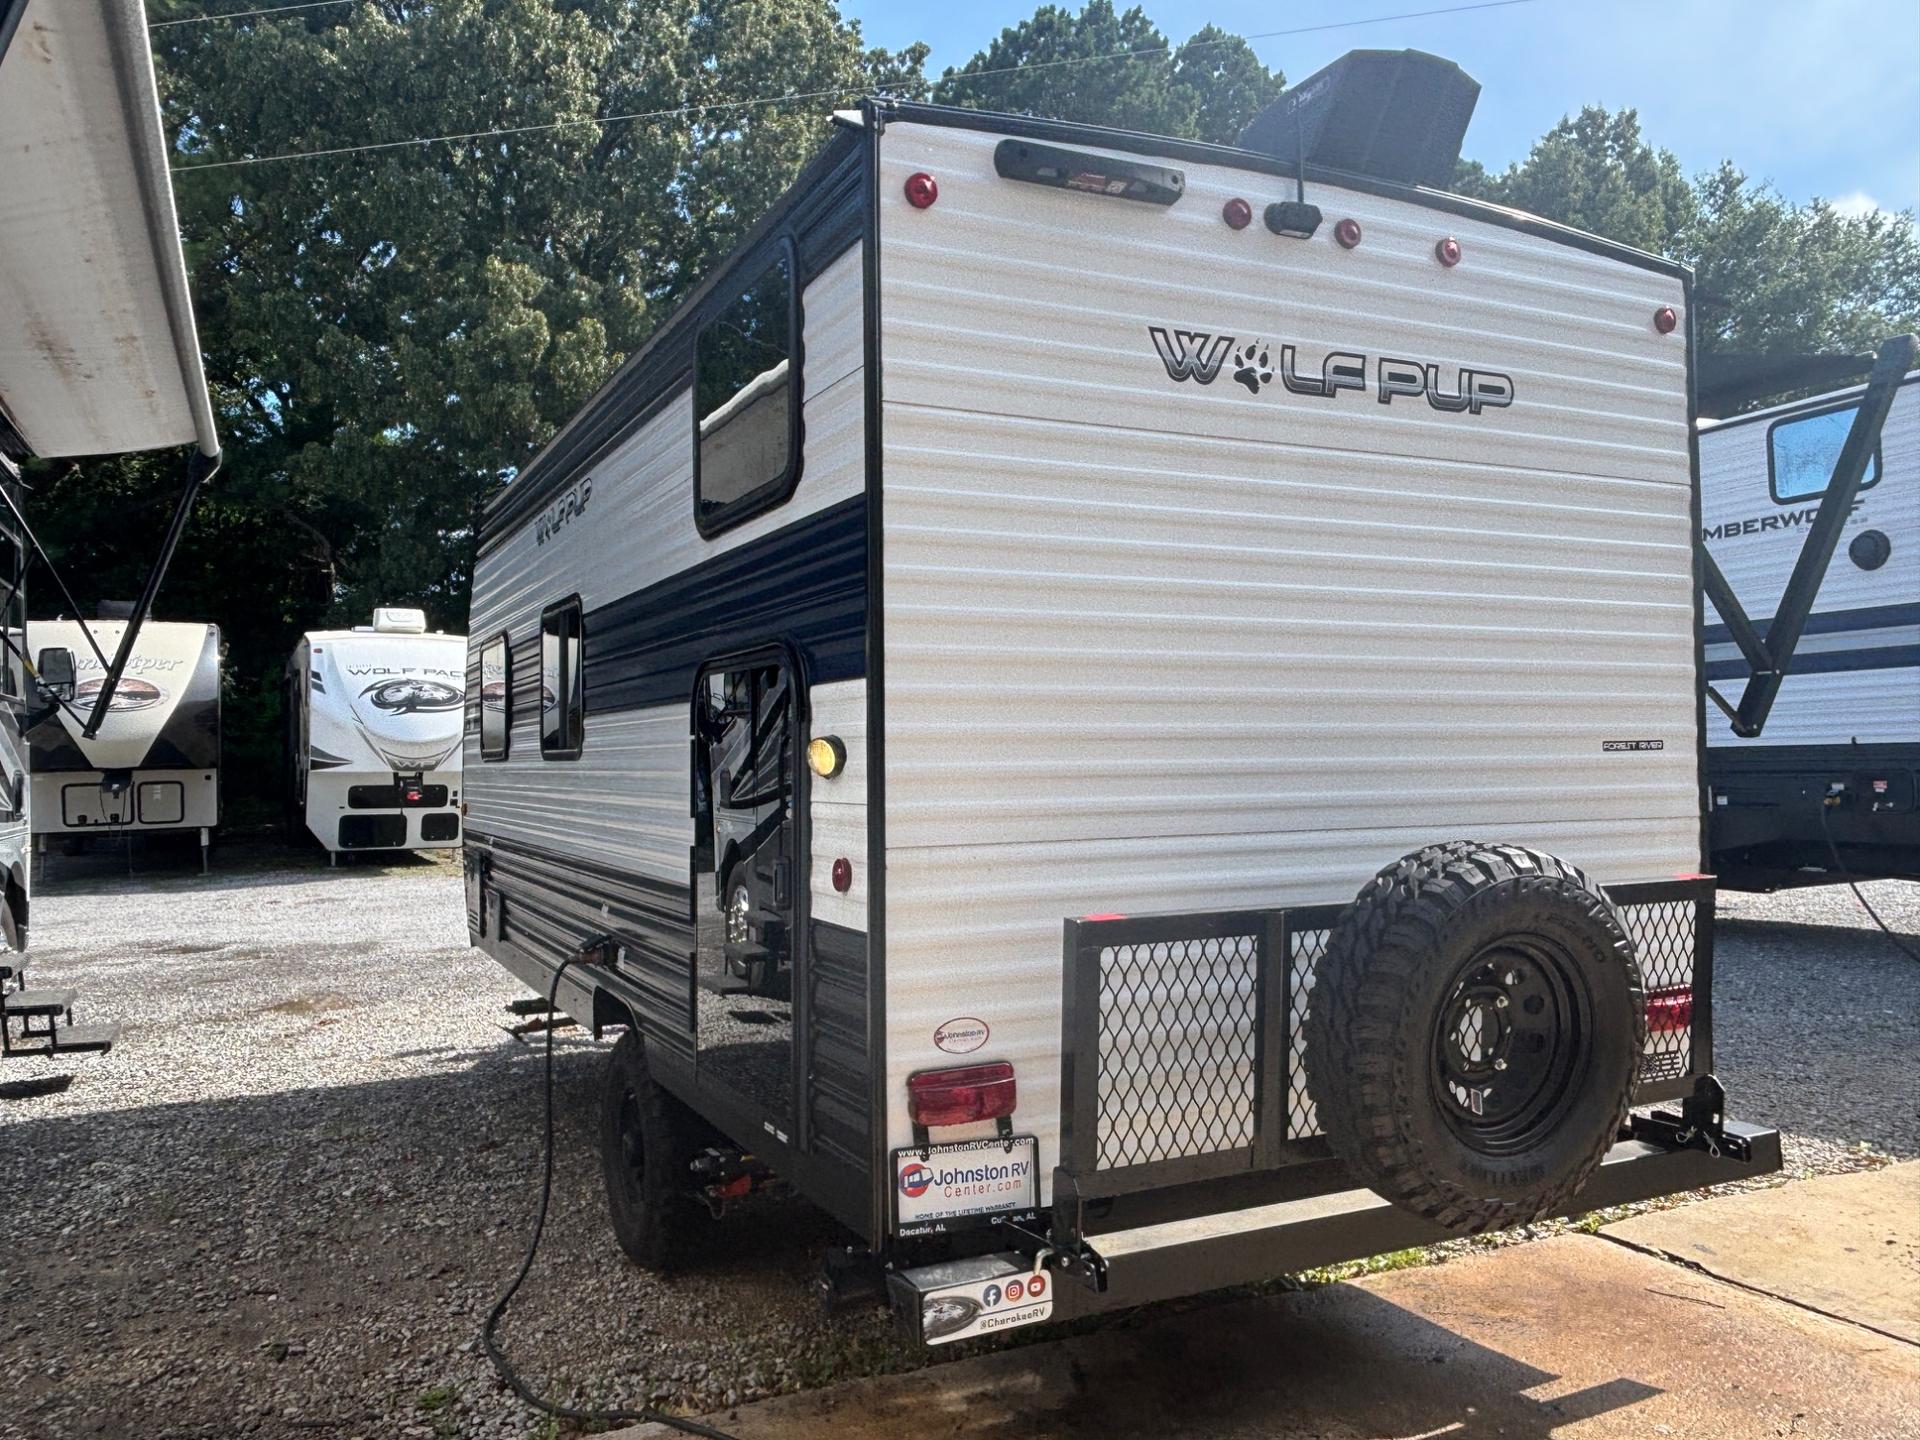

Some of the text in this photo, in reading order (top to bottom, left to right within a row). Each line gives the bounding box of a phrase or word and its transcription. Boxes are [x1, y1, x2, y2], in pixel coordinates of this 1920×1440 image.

[1378, 357, 1514, 415] PUP
[347, 667, 416, 676] WOLF
[423, 668, 467, 677] PAC
[934, 1161, 1030, 1186] Johnston RV
[944, 1179, 1022, 1198] Center.com
[935, 1223, 947, 1233] AL
